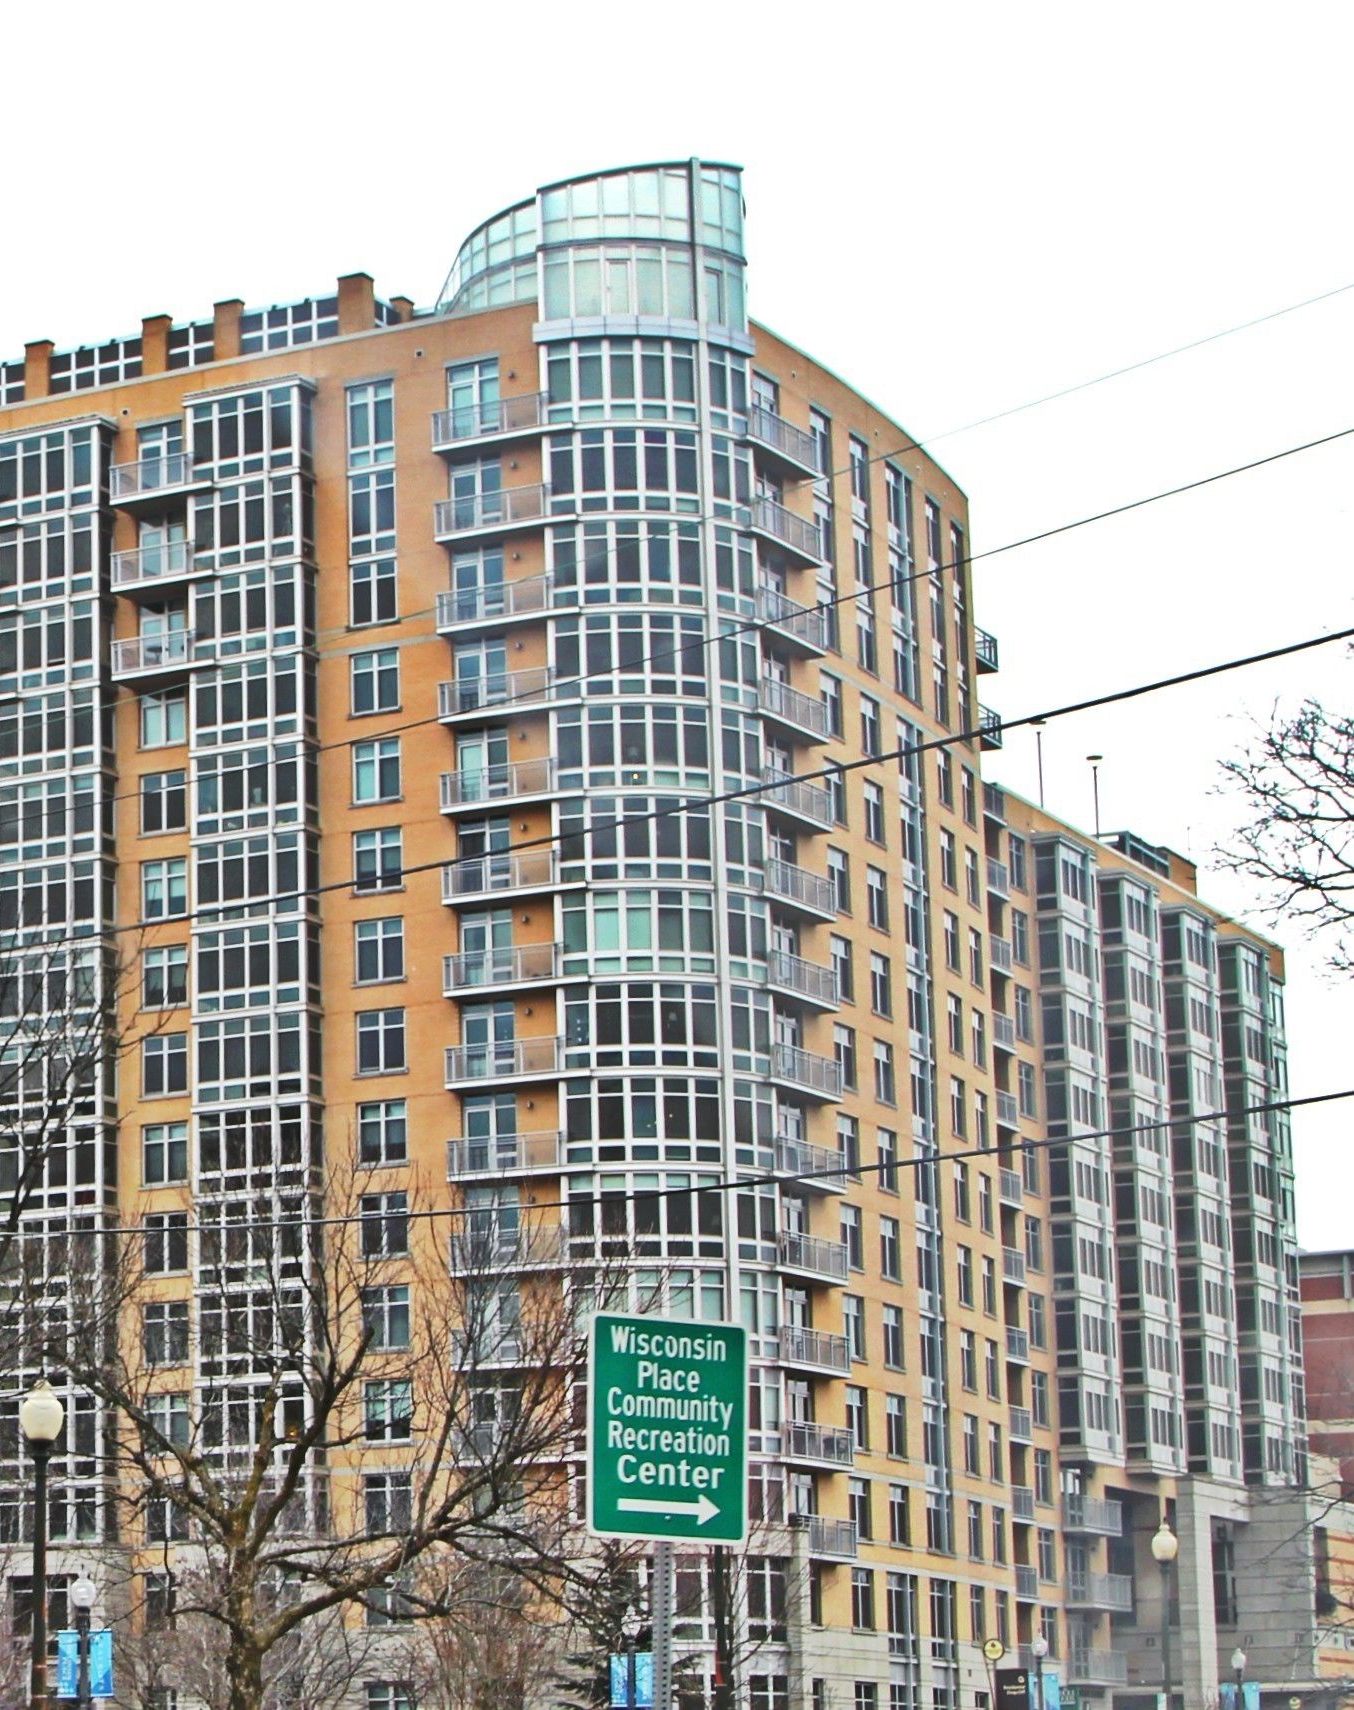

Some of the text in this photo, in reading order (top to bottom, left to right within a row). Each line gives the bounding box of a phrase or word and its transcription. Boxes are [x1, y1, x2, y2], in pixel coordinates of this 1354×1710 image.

[611, 1326, 726, 1362] Wisconsin
[637, 1361, 701, 1392] Place
[607, 1387, 734, 1431] Community
[608, 1420, 730, 1456] Recreation
[617, 1454, 725, 1489] Center
